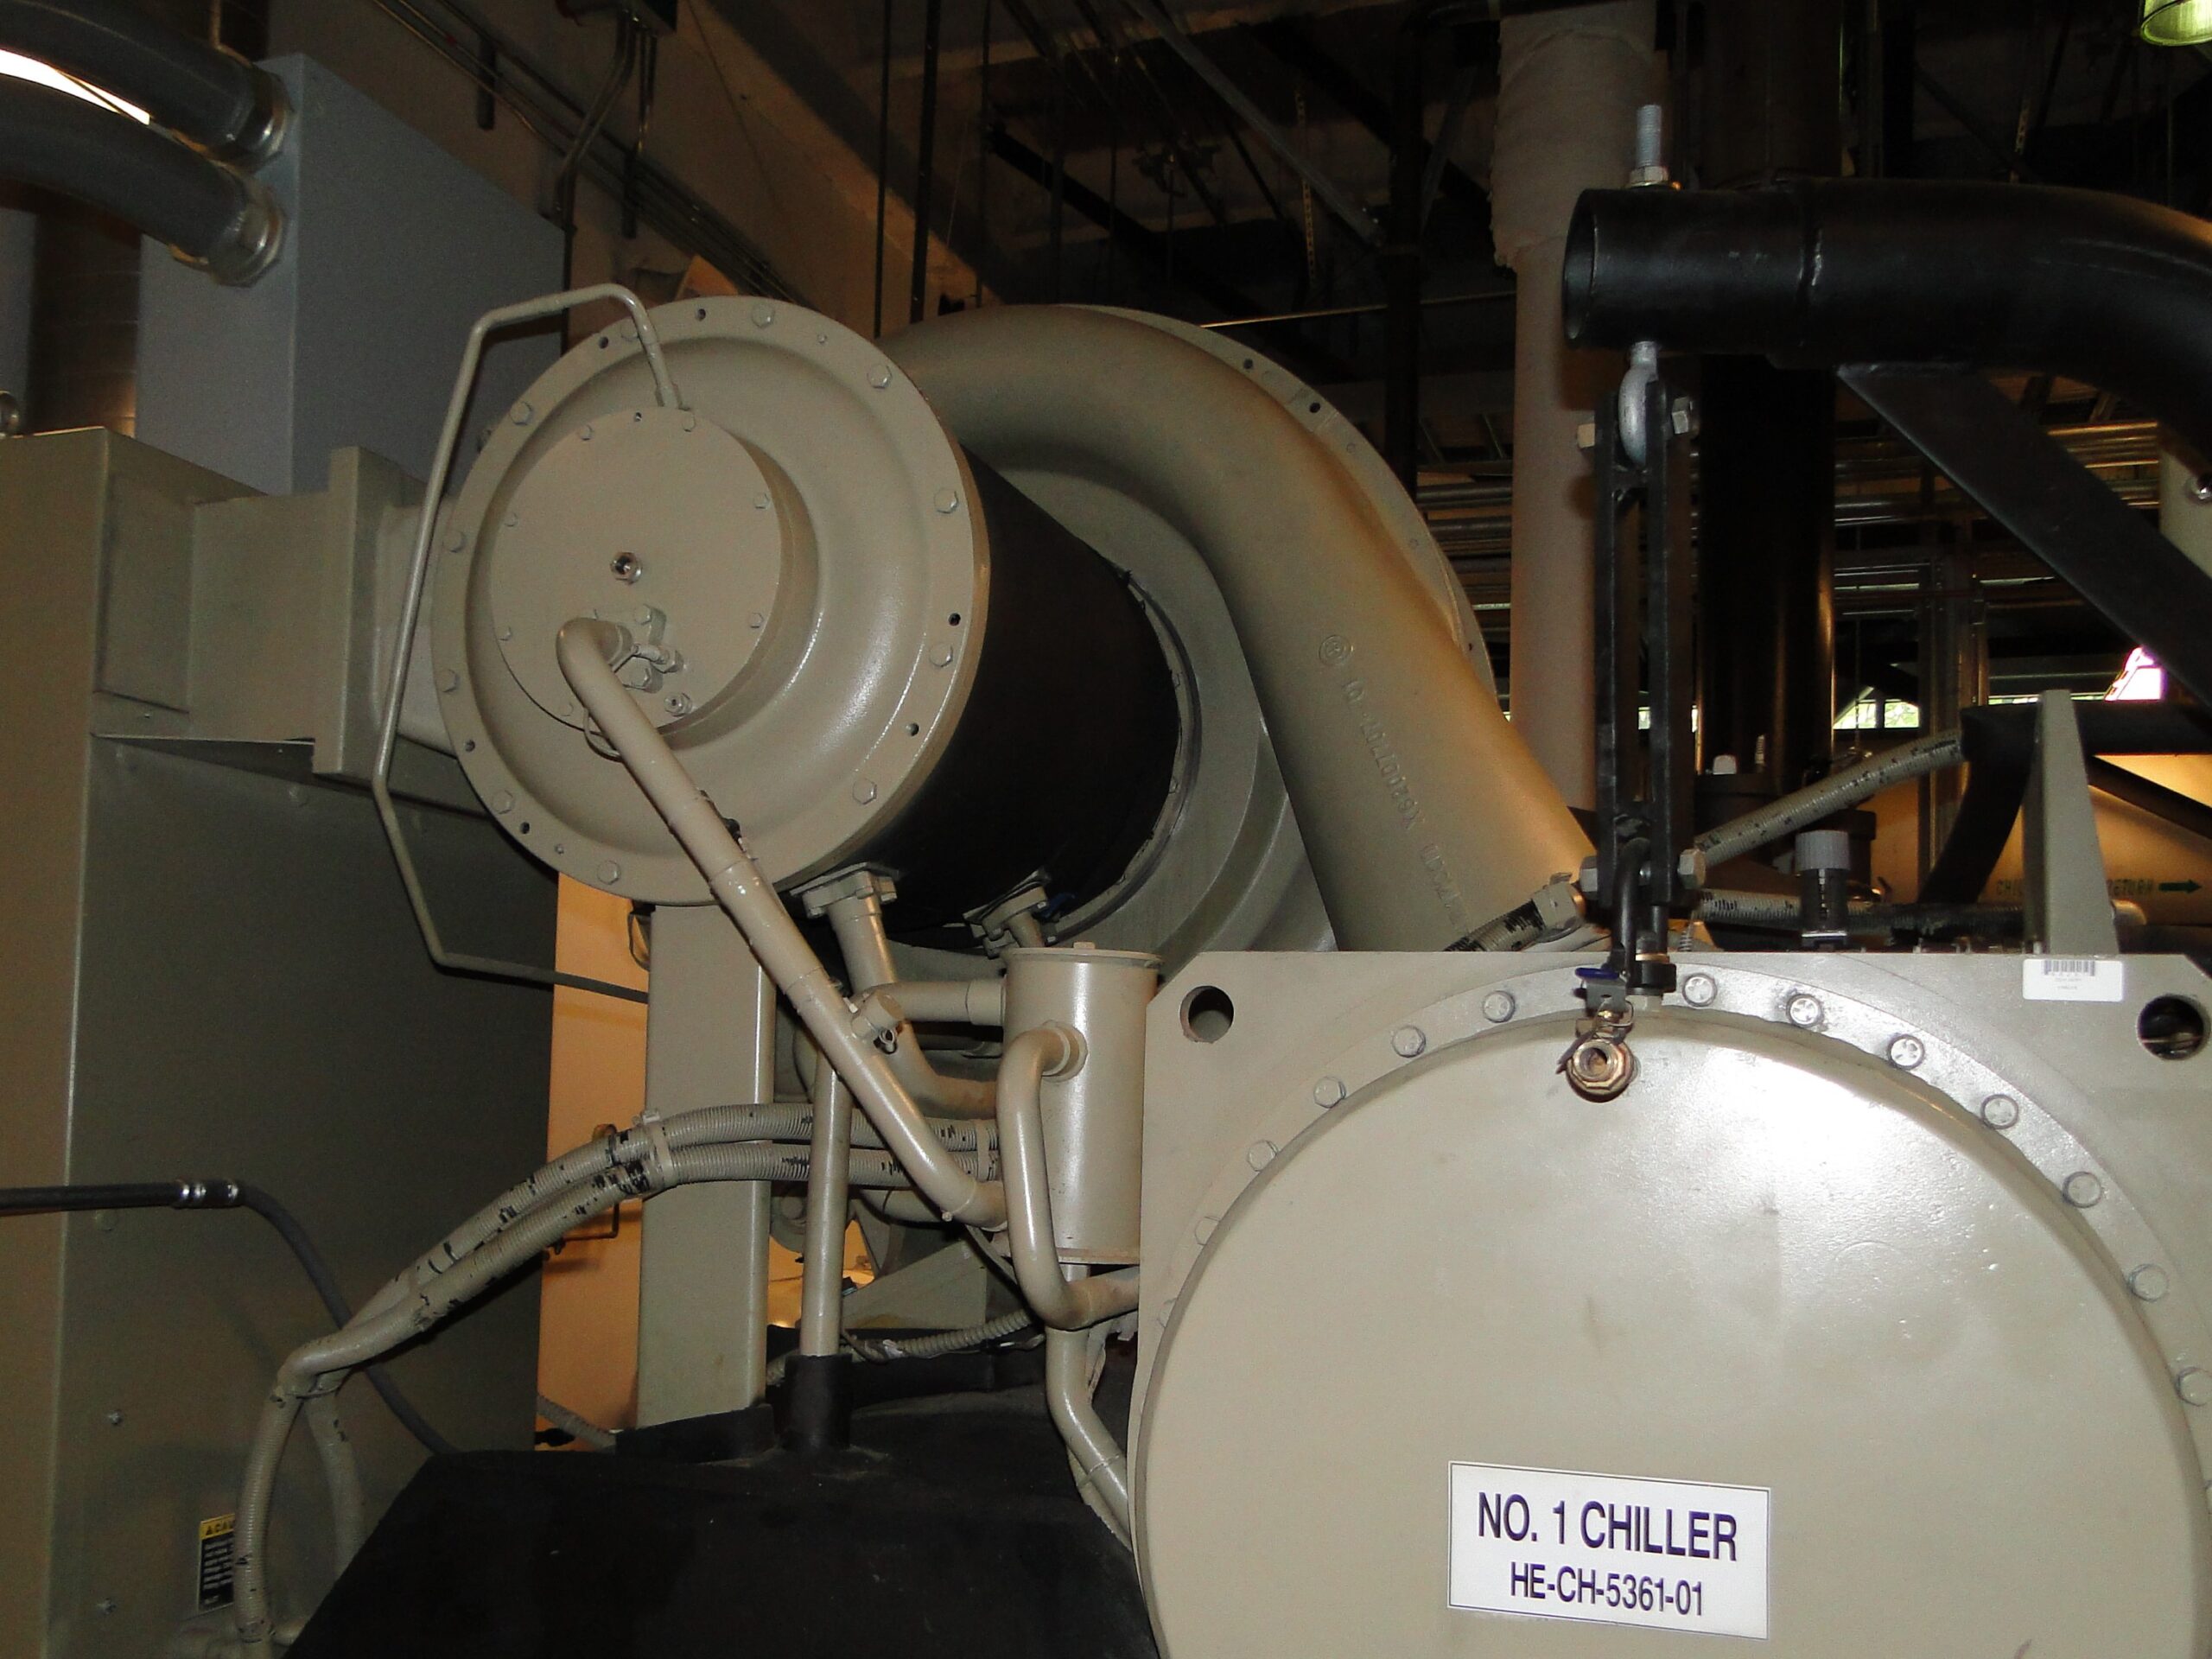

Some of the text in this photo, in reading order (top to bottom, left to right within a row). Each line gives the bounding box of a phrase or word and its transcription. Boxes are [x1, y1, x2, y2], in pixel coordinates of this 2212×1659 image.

[1478, 1491, 1738, 1561] NO. 1 CHILLER
[1510, 1561, 1702, 1616] HE-CH-5361-01
